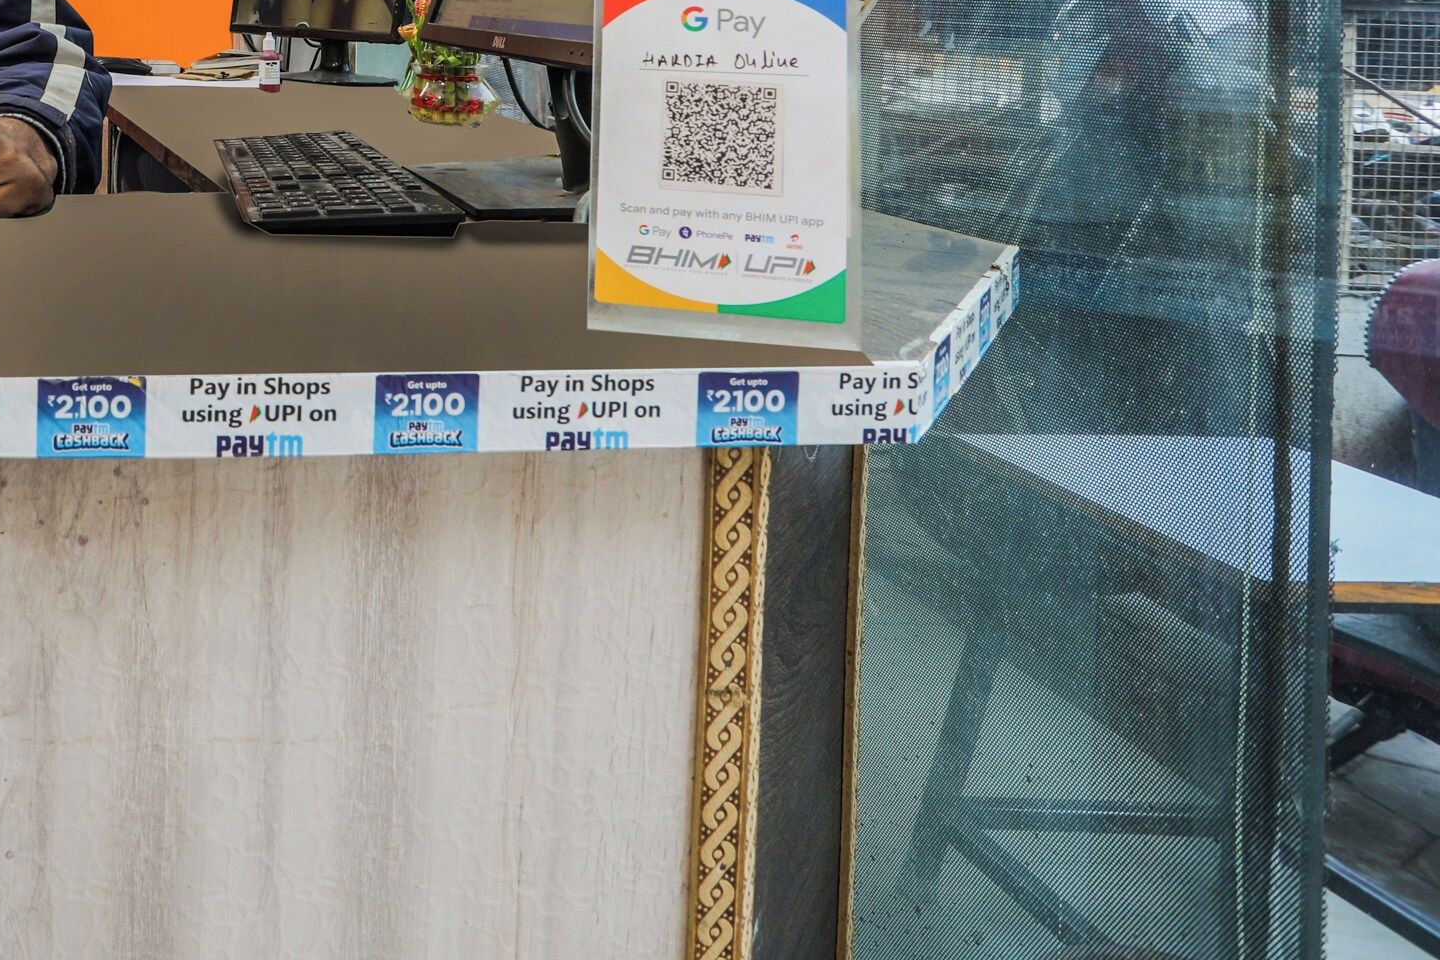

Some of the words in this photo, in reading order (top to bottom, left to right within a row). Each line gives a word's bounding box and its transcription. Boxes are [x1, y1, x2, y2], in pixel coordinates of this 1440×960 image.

[717, 8, 766, 38] Pay
[642, 52, 718, 69] HARDIA
[620, 203, 646, 213] Scan
[649, 205, 670, 215] and
[672, 208, 693, 220] pay
[695, 209, 720, 220] with
[722, 212, 742, 223] any
[745, 213, 776, 223] BHIM
[779, 215, 799, 225] UPI
[802, 218, 824, 228] app
[652, 225, 672, 238] Pay
[696, 230, 733, 241] PhonePe
[627, 245, 720, 270] BHIM
[744, 253, 806, 276] UPI
[71, 382, 88, 392] Get
[90, 383, 112, 393] upto
[191, 378, 230, 400] Pay
[237, 378, 256, 394] in
[264, 377, 330, 399] Shops
[521, 376, 558, 397] Pay
[566, 375, 583, 391] in
[592, 374, 654, 396] Shops
[840, 373, 876, 394] Pay
[883, 372, 900, 389] in
[183, 405, 242, 428] using
[265, 405, 301, 421] UPI
[310, 409, 336, 421] on
[513, 402, 570, 424] using
[592, 402, 627, 418] UPI
[635, 406, 660, 417] on
[832, 399, 887, 421] using
